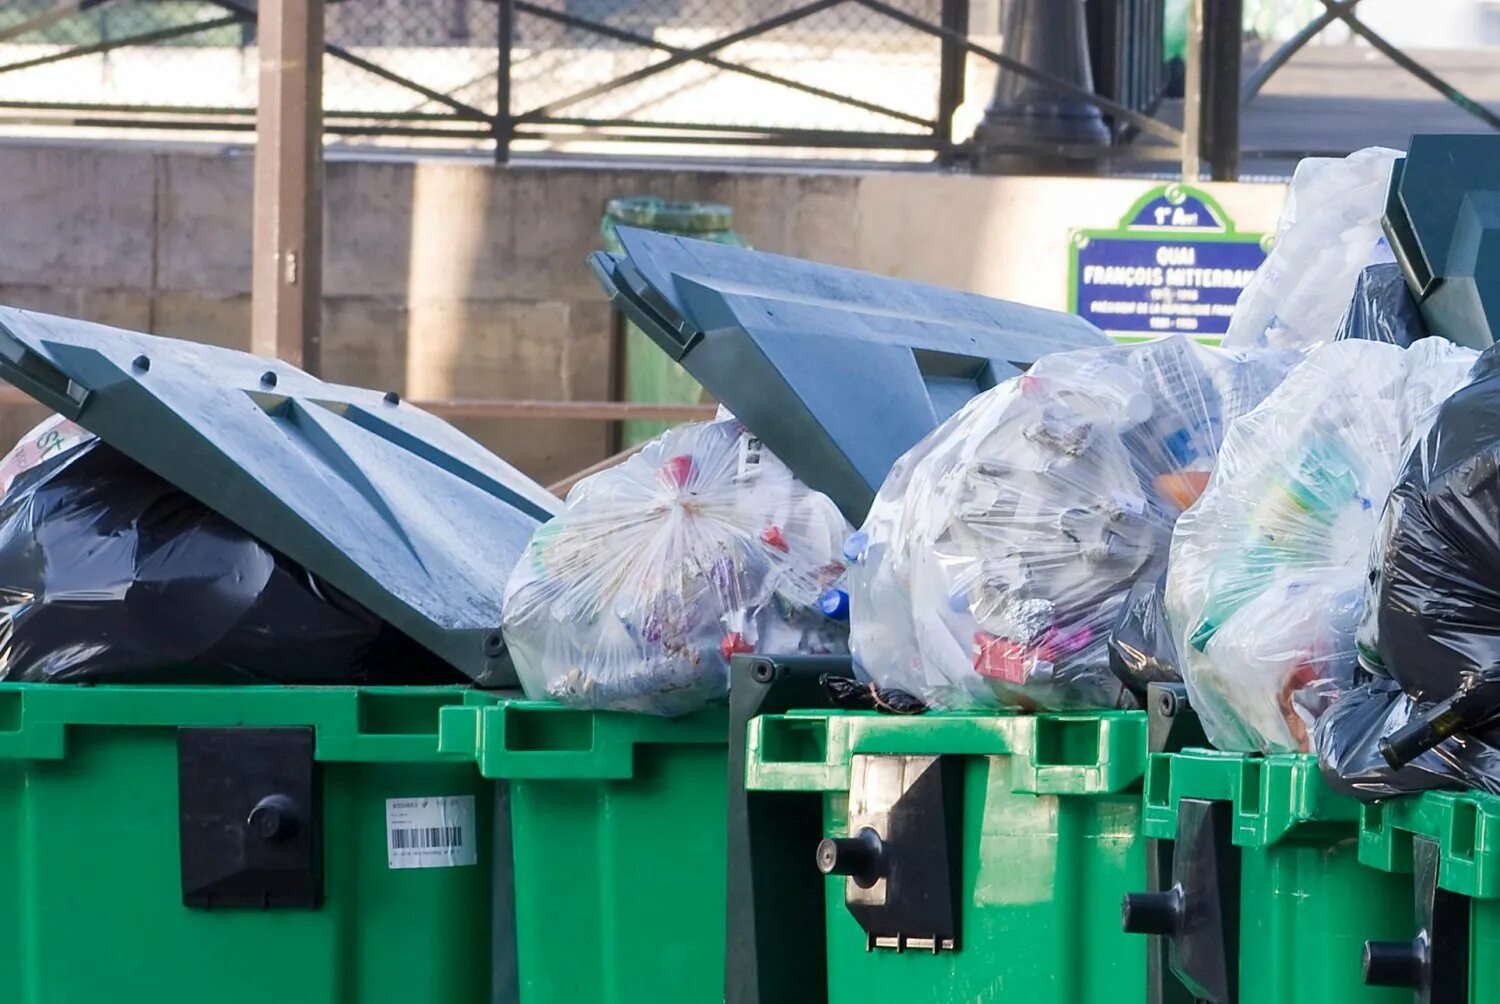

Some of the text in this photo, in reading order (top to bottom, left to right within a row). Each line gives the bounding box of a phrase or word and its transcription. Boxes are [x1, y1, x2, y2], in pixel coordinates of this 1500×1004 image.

[1156, 246, 1195, 266] QUAI
[1083, 265, 1256, 288] FRANÇOIS MITTERRAN
